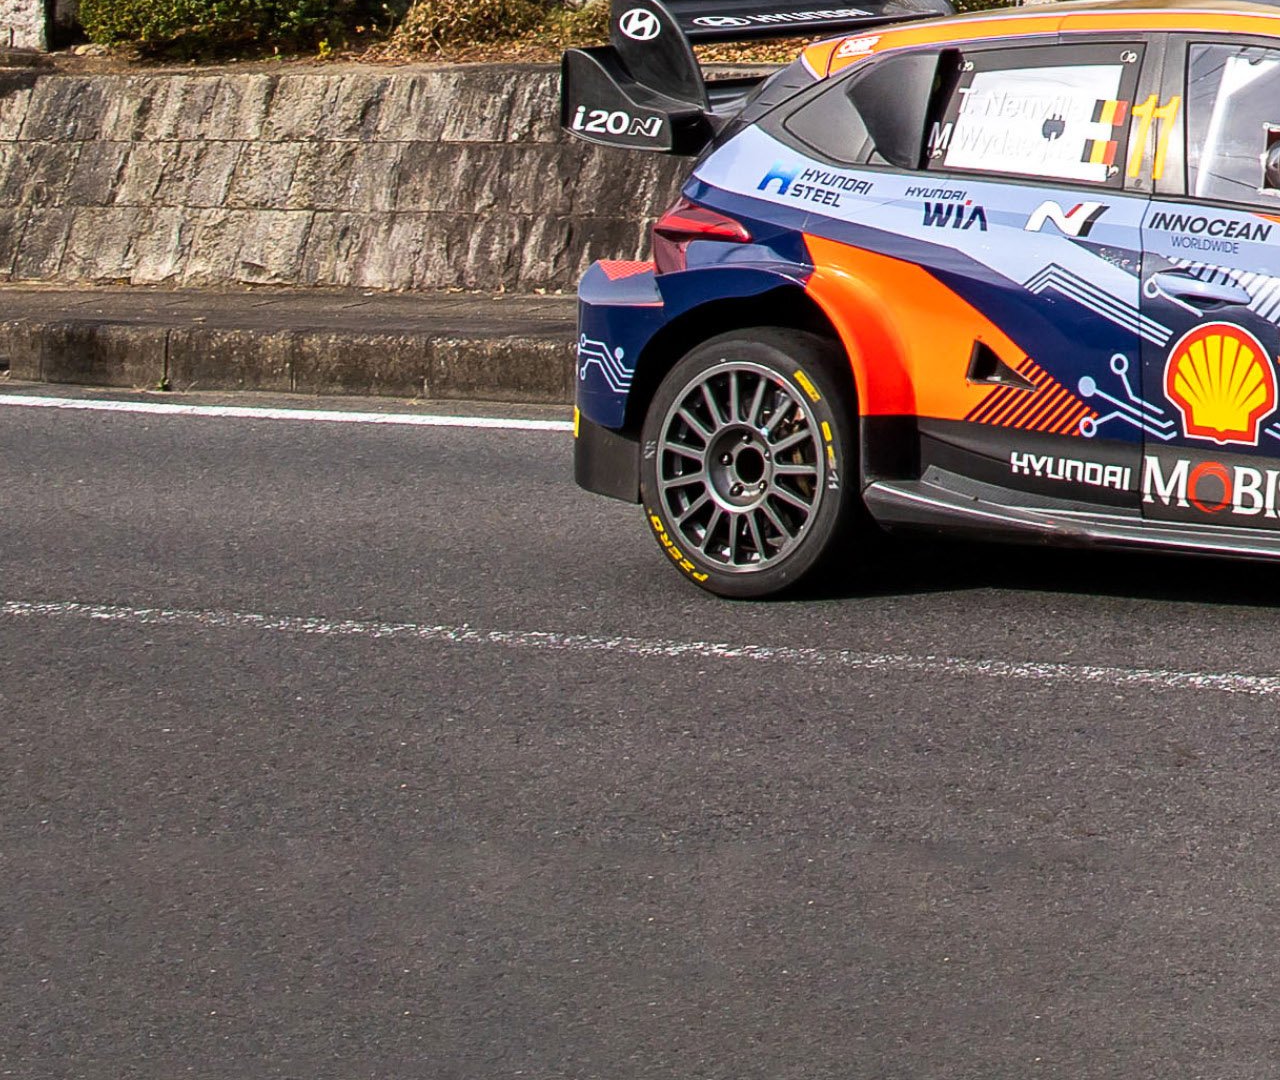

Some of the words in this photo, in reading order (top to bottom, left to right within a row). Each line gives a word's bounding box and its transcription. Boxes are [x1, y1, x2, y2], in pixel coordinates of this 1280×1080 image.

[746, 8, 874, 24] HYUNDAI
[1128, 94, 1181, 180] 11
[801, 168, 873, 195] HYUNDAI
[905, 186, 967, 201] HYUNDAI
[790, 184, 841, 208] STEEL
[922, 200, 988, 231] WIA
[1149, 212, 1272, 241] INNOCEAN
[1171, 235, 1240, 254] WORLDWIDE
[1010, 452, 1130, 491] HYUNDAI
